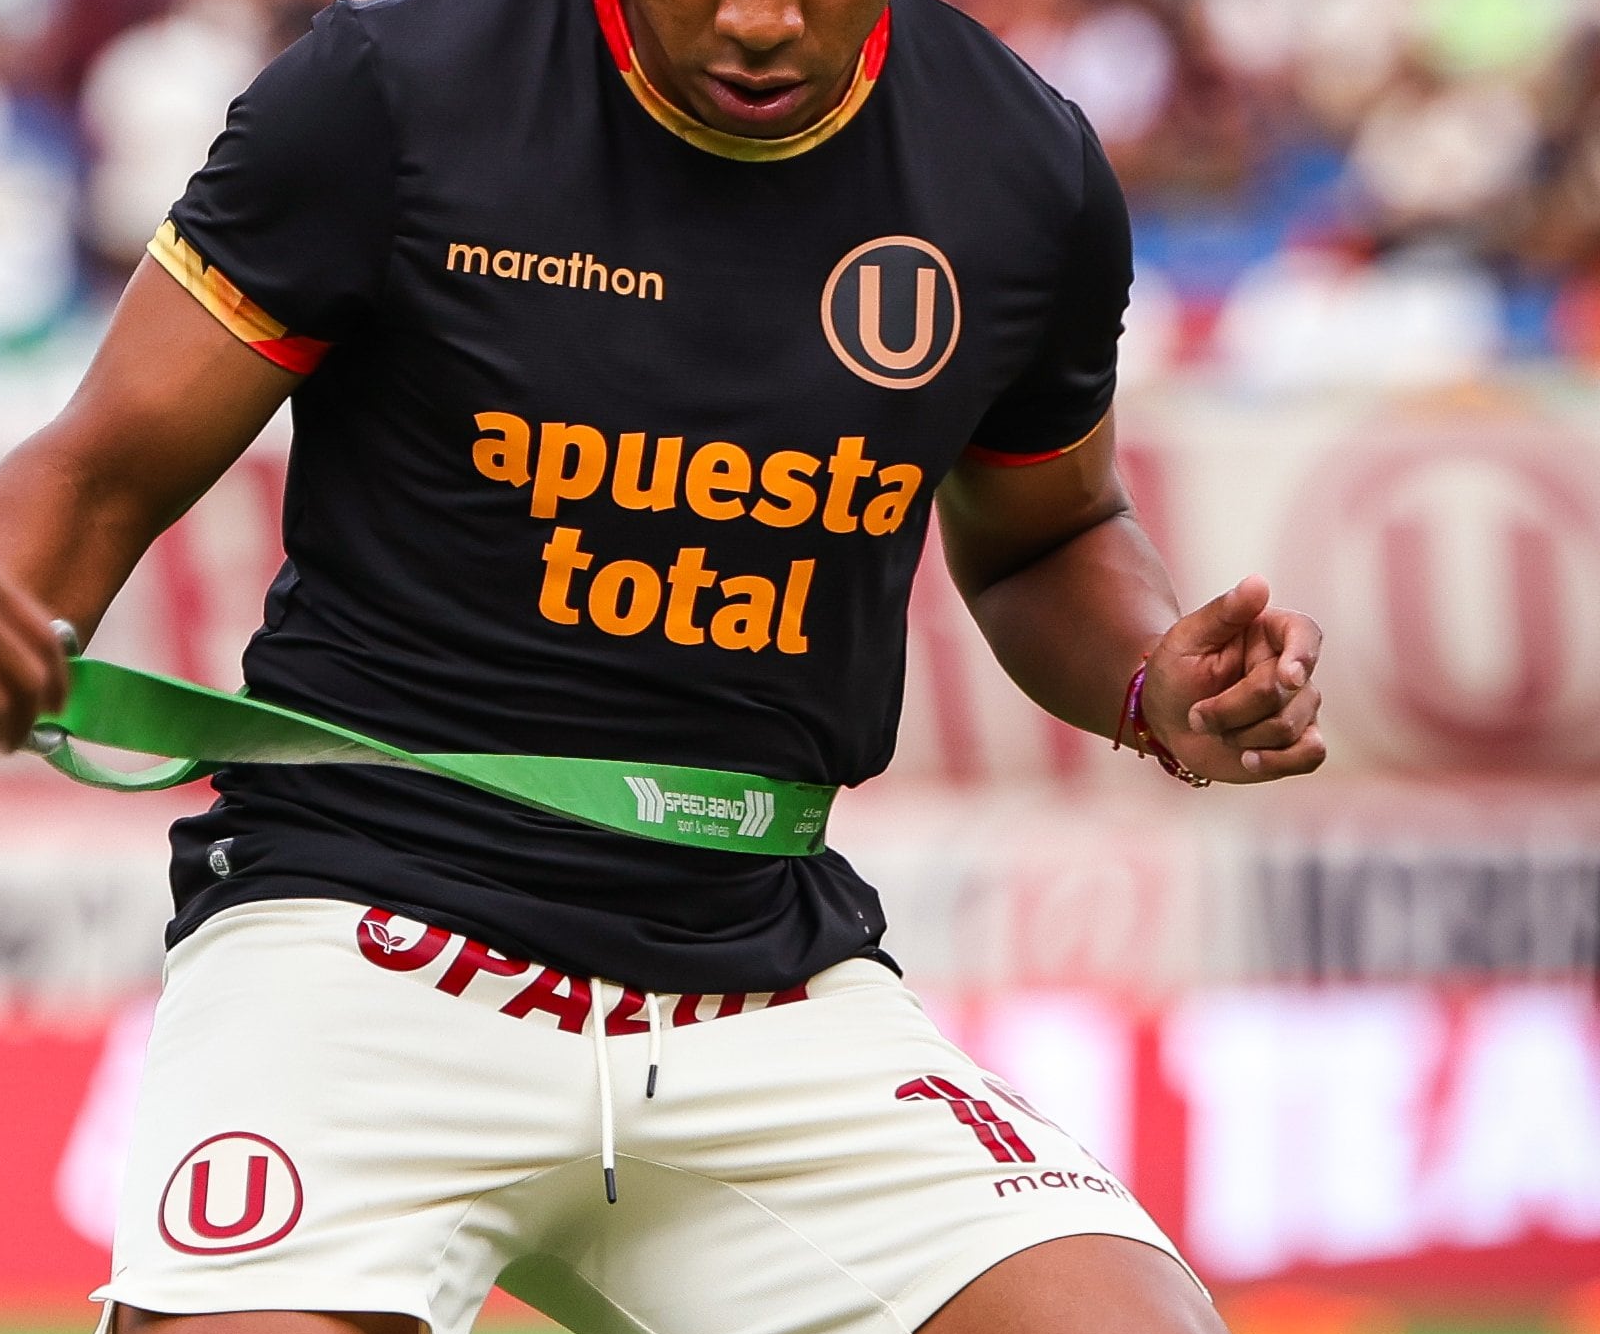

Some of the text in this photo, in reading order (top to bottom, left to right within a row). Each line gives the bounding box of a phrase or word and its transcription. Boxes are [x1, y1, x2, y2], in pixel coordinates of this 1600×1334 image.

[446, 241, 665, 301] marathon
[857, 264, 937, 371] U
[472, 410, 923, 536] apuesta
[538, 525, 816, 654] total
[356, 904, 810, 1037] OPAL
[188, 1155, 268, 1239] U
